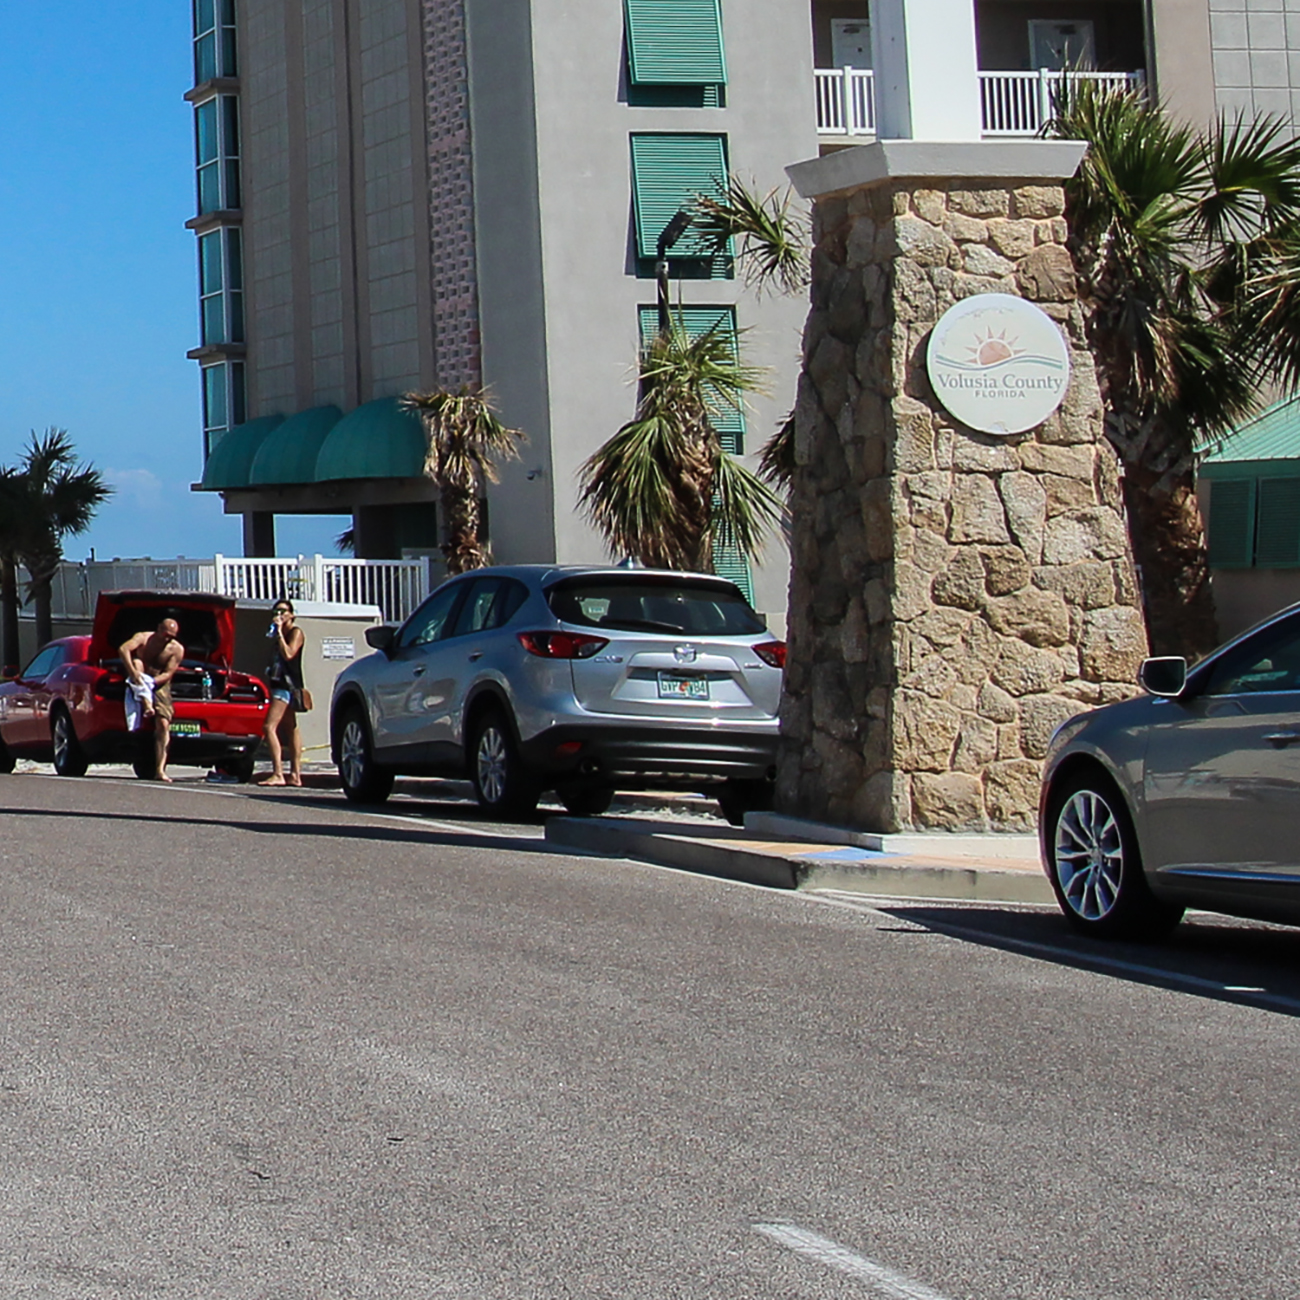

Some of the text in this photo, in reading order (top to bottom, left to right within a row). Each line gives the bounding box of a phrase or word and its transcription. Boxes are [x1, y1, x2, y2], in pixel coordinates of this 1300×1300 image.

[938, 373, 1063, 394] Volusia County
[975, 390, 1026, 398] FLORIDA
